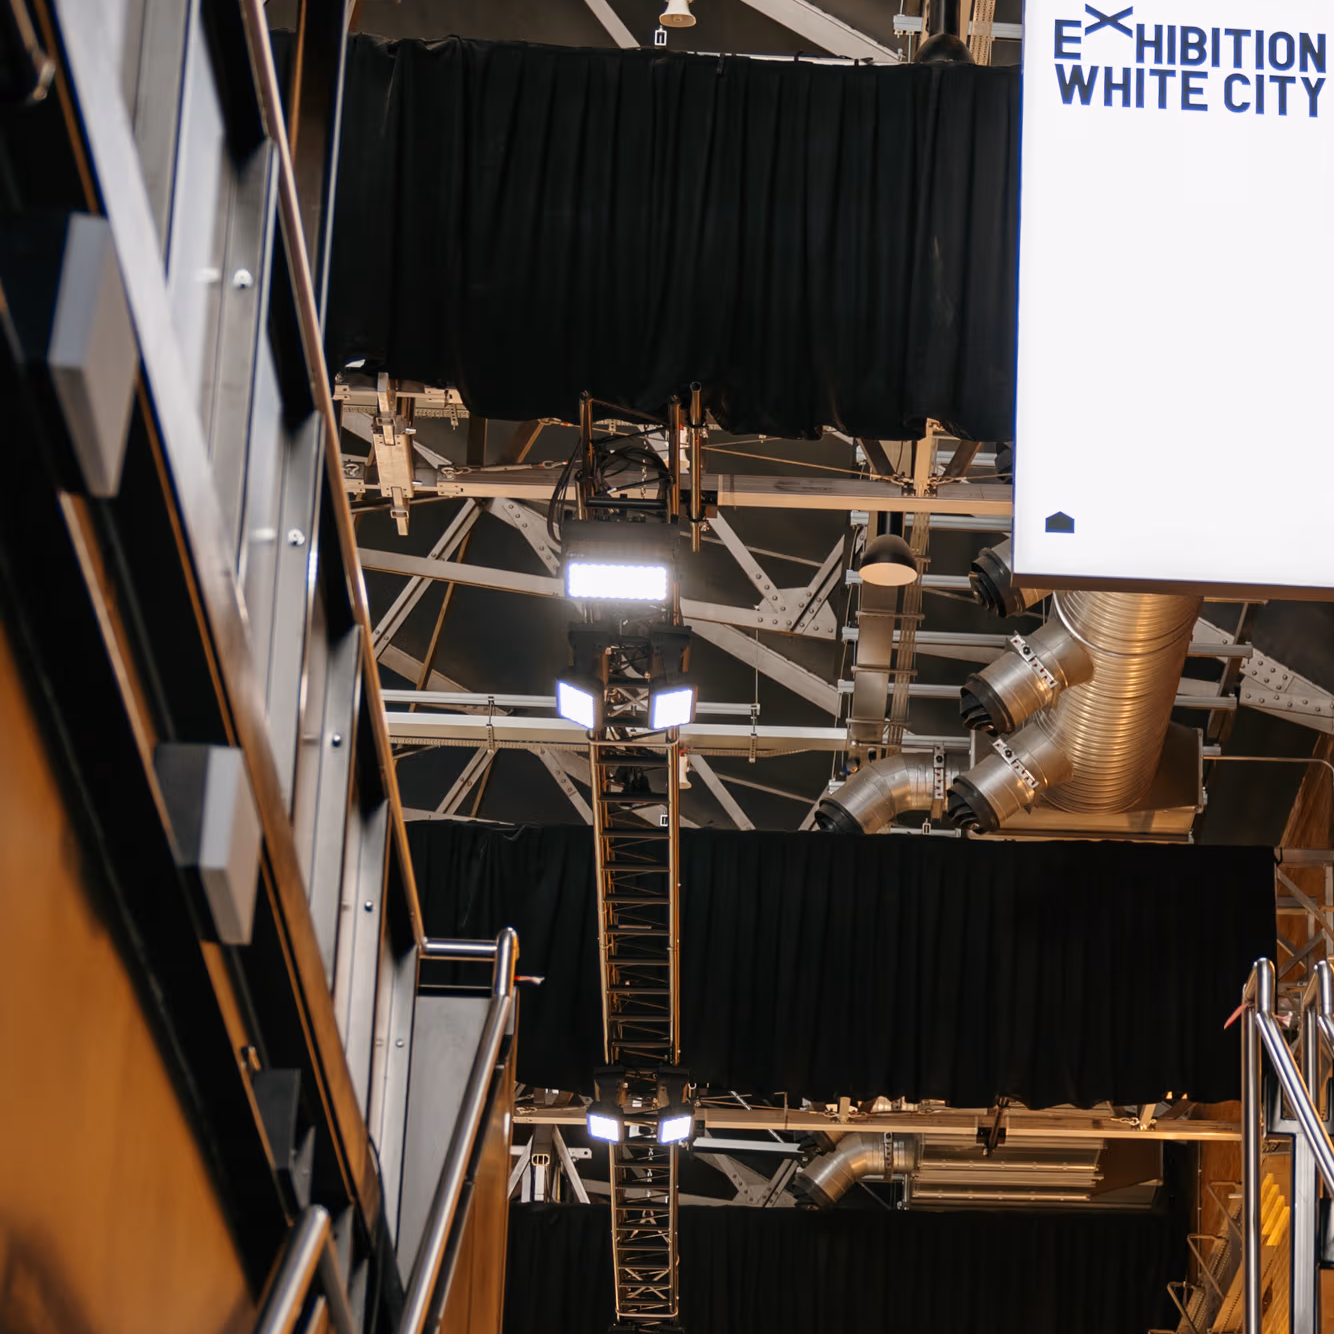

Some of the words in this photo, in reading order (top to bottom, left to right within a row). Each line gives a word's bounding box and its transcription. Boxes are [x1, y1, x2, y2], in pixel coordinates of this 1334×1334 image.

[1053, 3, 1327, 74] EXHIBITION
[1054, 63, 1209, 112] WHITE
[1223, 73, 1326, 118] CITY
